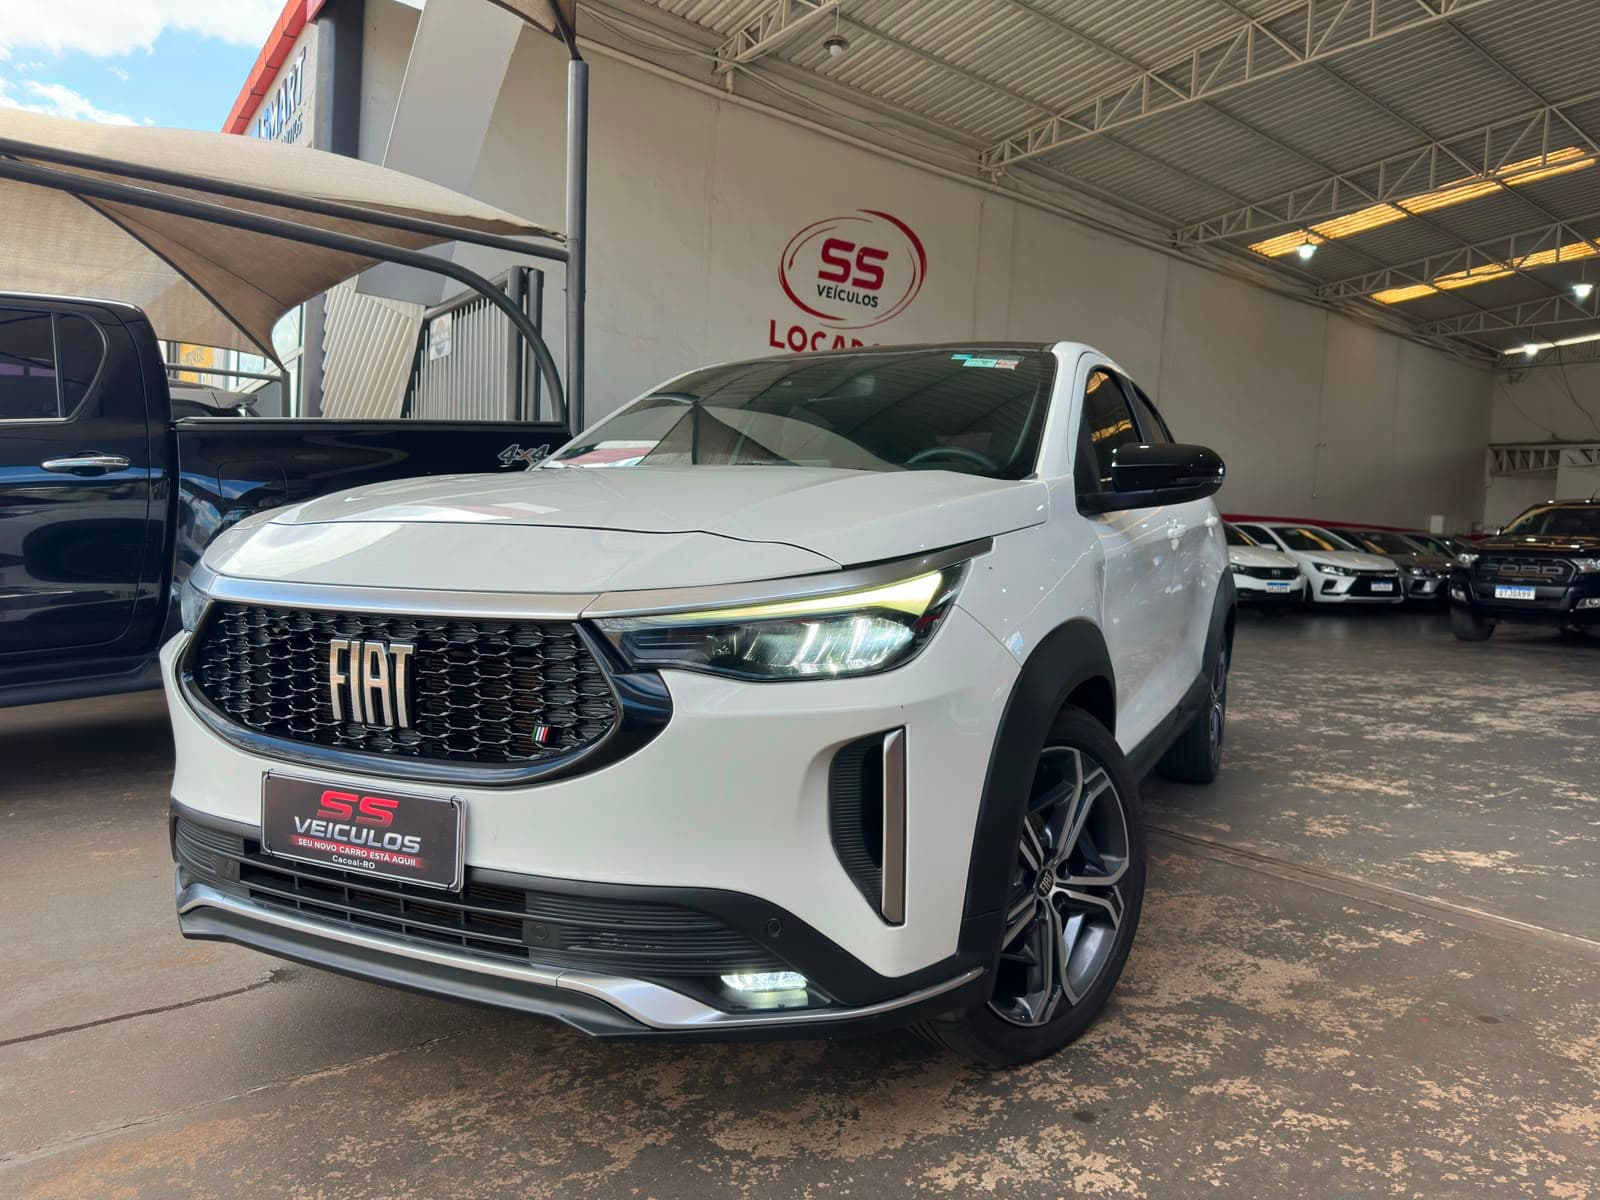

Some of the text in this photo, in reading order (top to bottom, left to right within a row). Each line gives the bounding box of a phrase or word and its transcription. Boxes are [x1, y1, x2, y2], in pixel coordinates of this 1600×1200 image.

[818, 238, 889, 291] SS
[816, 283, 879, 308] VEÍCULOS
[329, 638, 415, 729] FIAT
[316, 790, 399, 828] SS
[294, 815, 422, 854] VEICULOS
[297, 838, 313, 847] SEU
[314, 841, 337, 852] NOVO
[339, 846, 368, 858] CARRO
[369, 851, 390, 862] ESTÁ
[332, 854, 376, 870] Cacoal-RO
